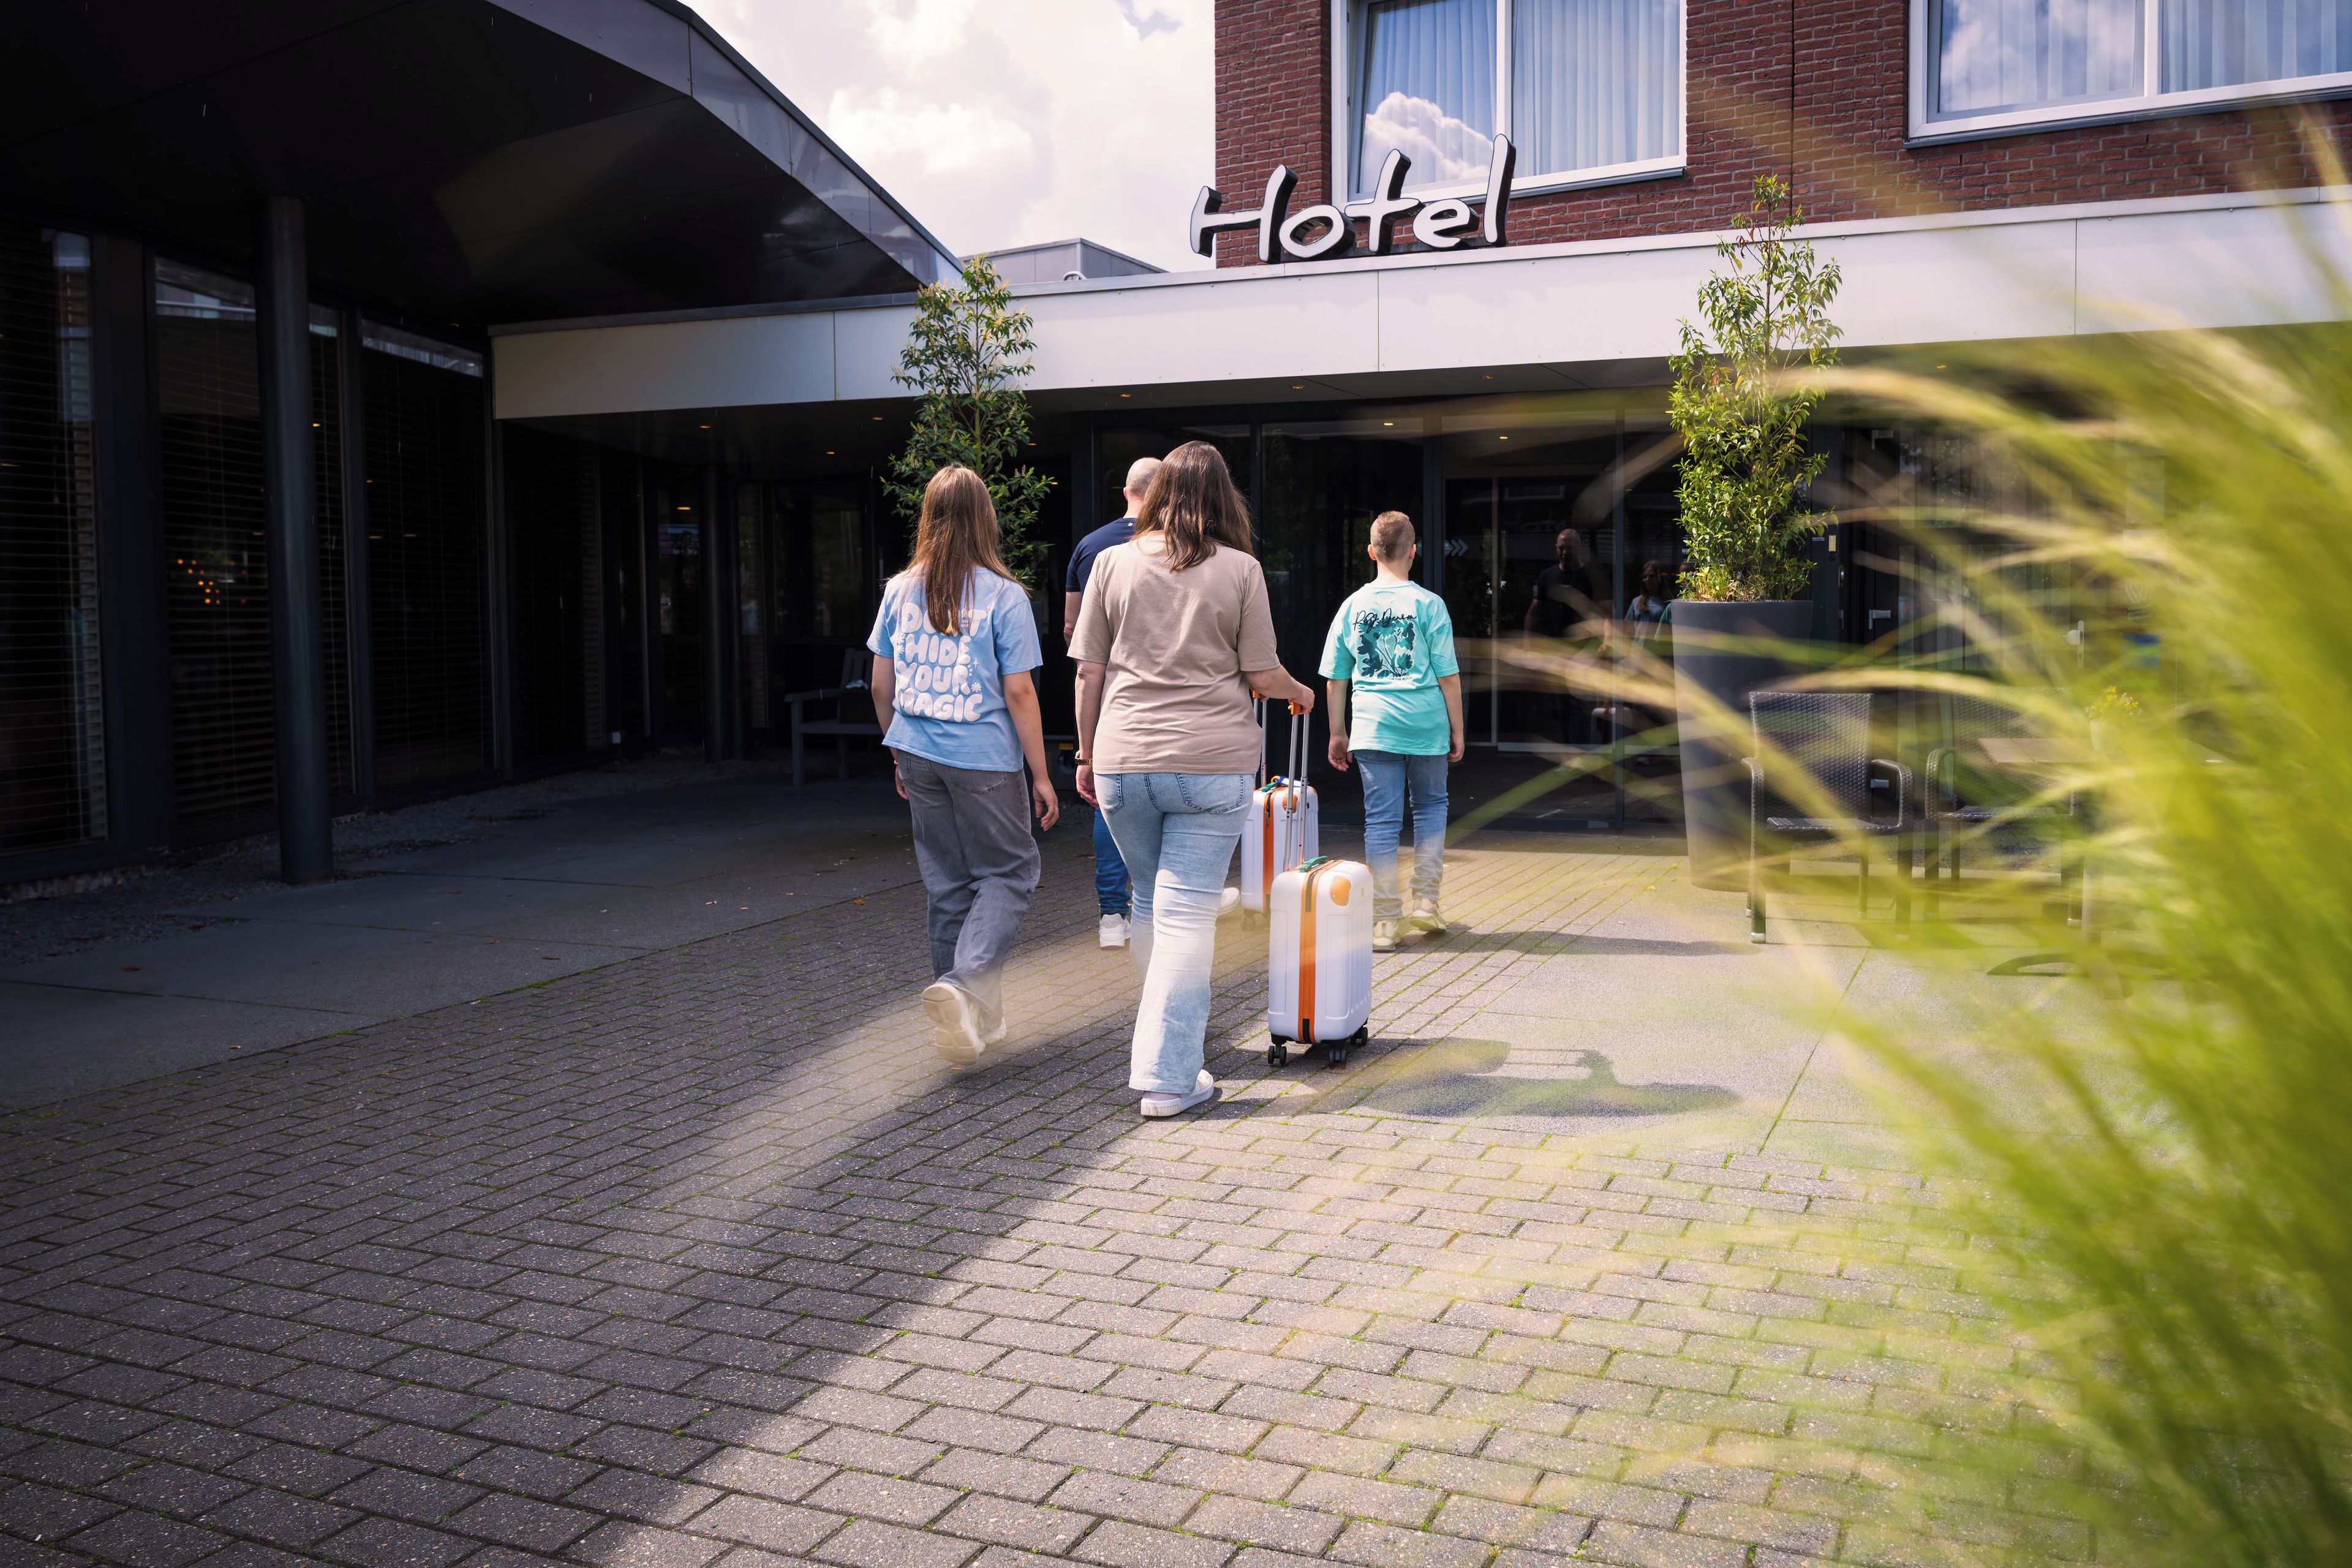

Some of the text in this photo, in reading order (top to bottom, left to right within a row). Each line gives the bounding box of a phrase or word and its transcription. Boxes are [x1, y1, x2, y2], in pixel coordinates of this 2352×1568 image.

[1190, 134, 1516, 263] Hotel
[905, 633, 971, 666] HIDE
[897, 661, 971, 696] YOUR
[897, 687, 983, 723] MAGIC
